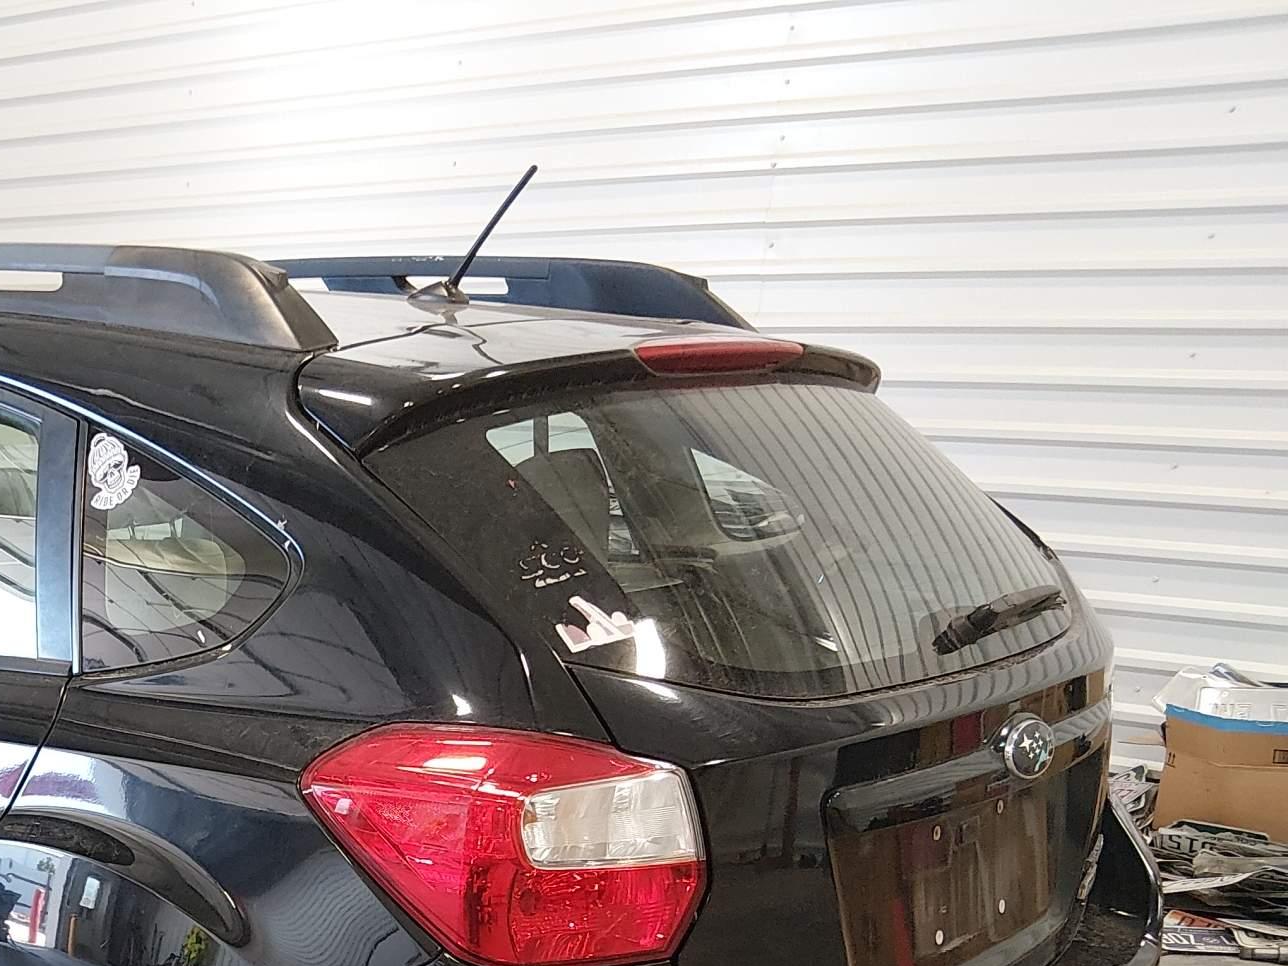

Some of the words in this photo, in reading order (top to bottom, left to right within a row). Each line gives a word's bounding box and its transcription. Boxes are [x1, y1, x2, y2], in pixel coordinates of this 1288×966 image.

[94, 495, 113, 506] RIDE
[116, 488, 129, 501] OR
[126, 469, 139, 485] DIE
